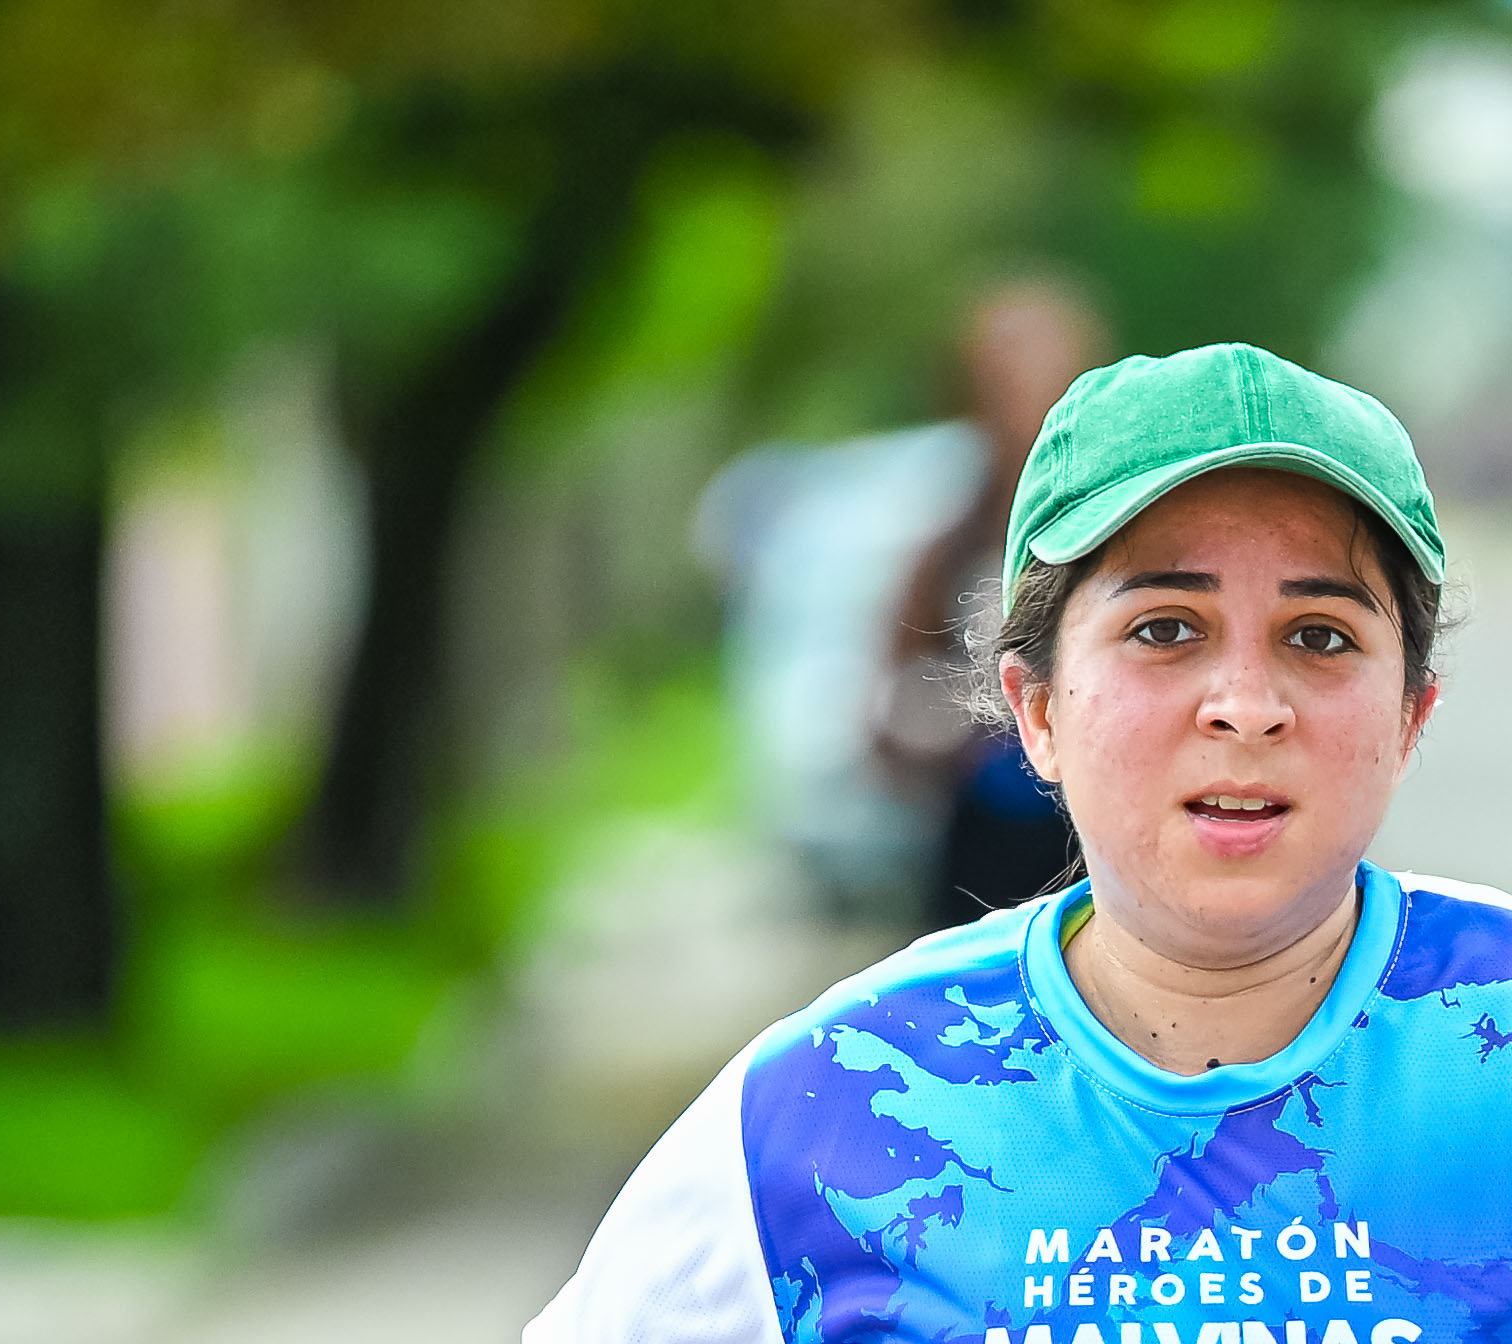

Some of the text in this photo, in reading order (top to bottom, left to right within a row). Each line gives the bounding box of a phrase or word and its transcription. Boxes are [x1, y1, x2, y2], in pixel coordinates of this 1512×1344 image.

[1025, 1216, 1370, 1264] MARATÓN
[1024, 1268, 1373, 1307] HÉROES DE
